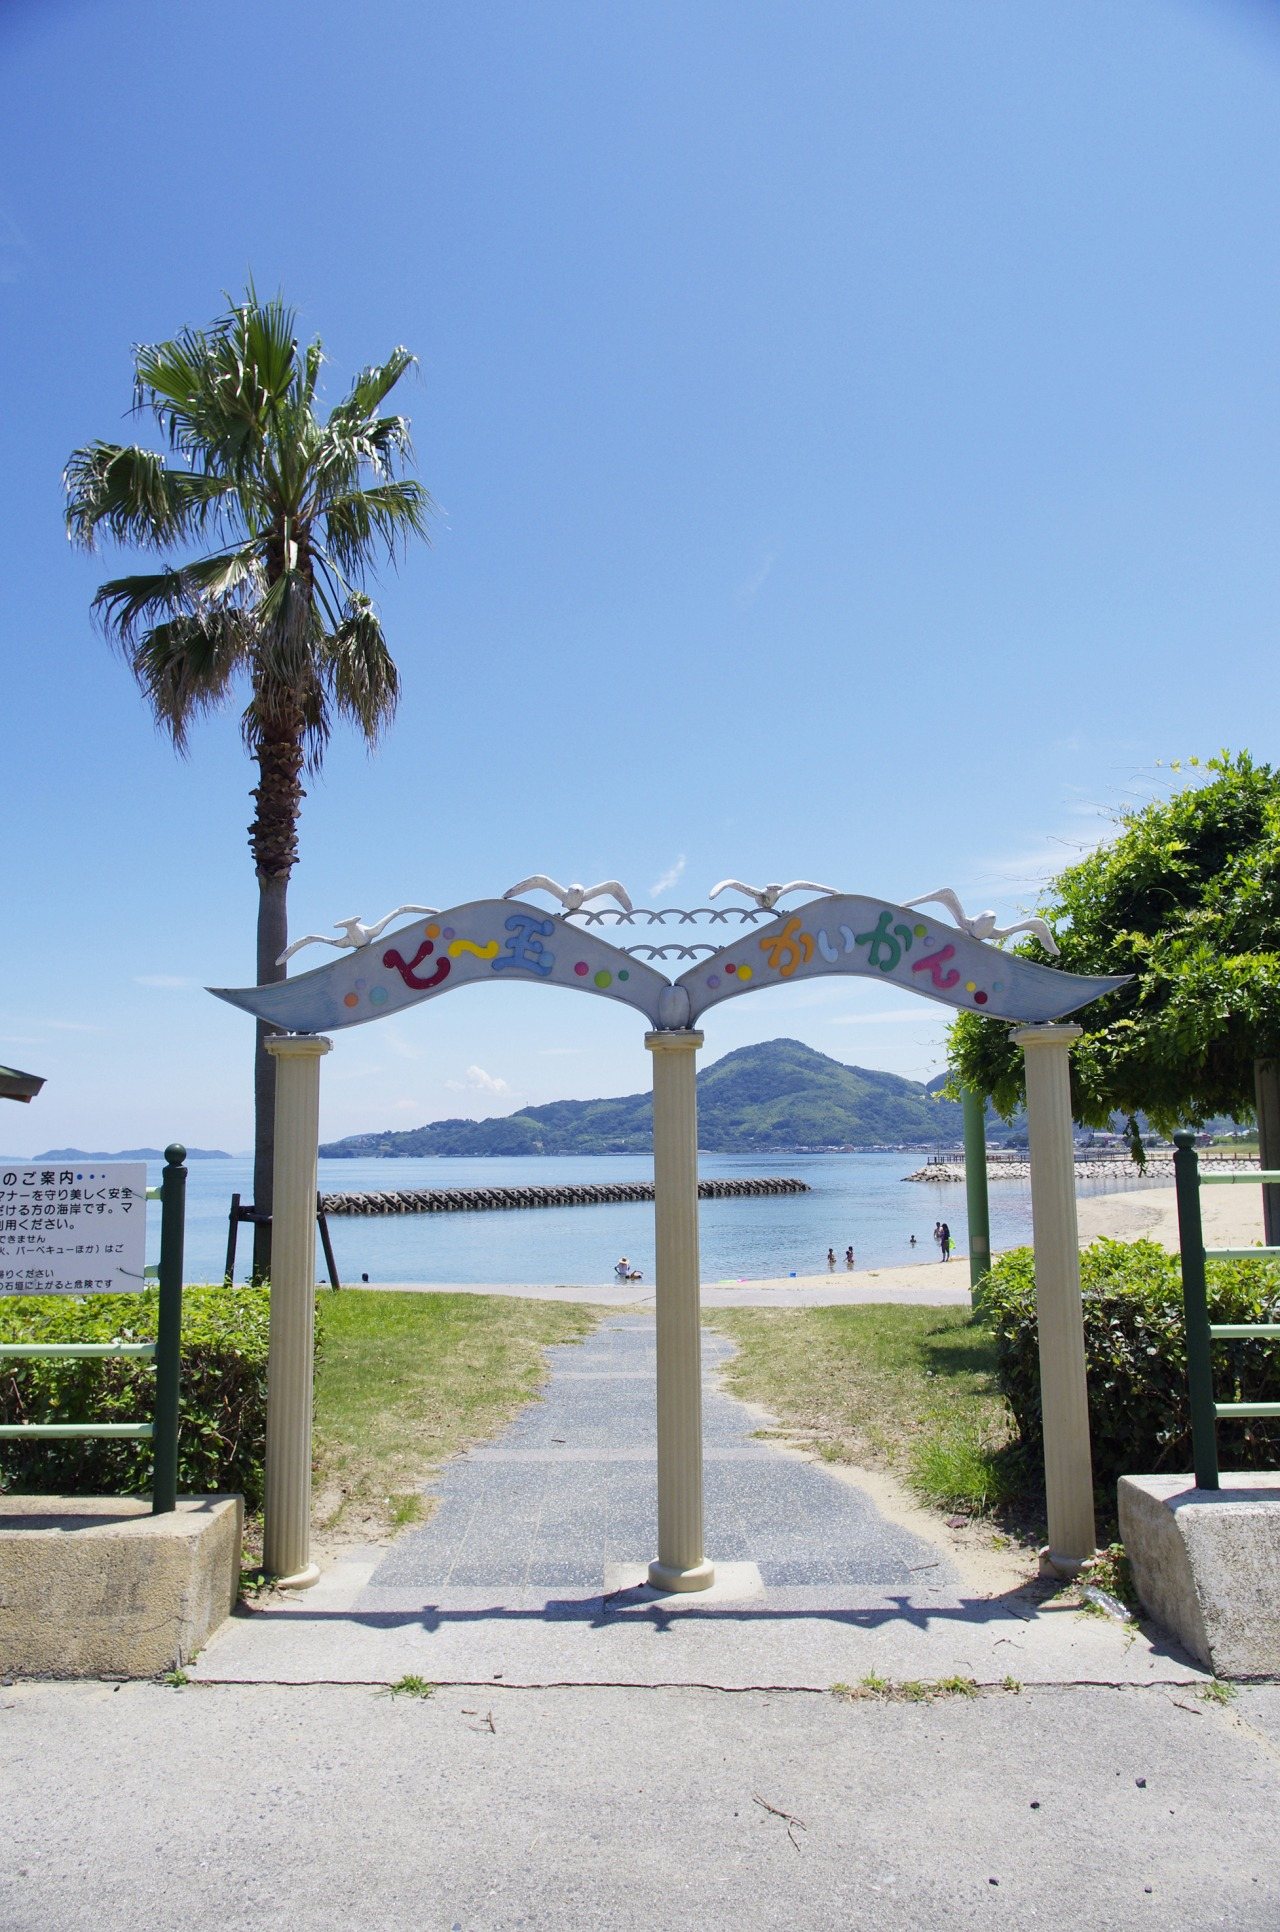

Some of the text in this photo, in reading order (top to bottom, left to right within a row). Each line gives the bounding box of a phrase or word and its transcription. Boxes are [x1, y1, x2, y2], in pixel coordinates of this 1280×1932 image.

[761, 911, 961, 990] かいがん
[0, 1219, 75, 1231] 用ください。
[0, 1279, 113, 1291] 石垣に上がると危険です
